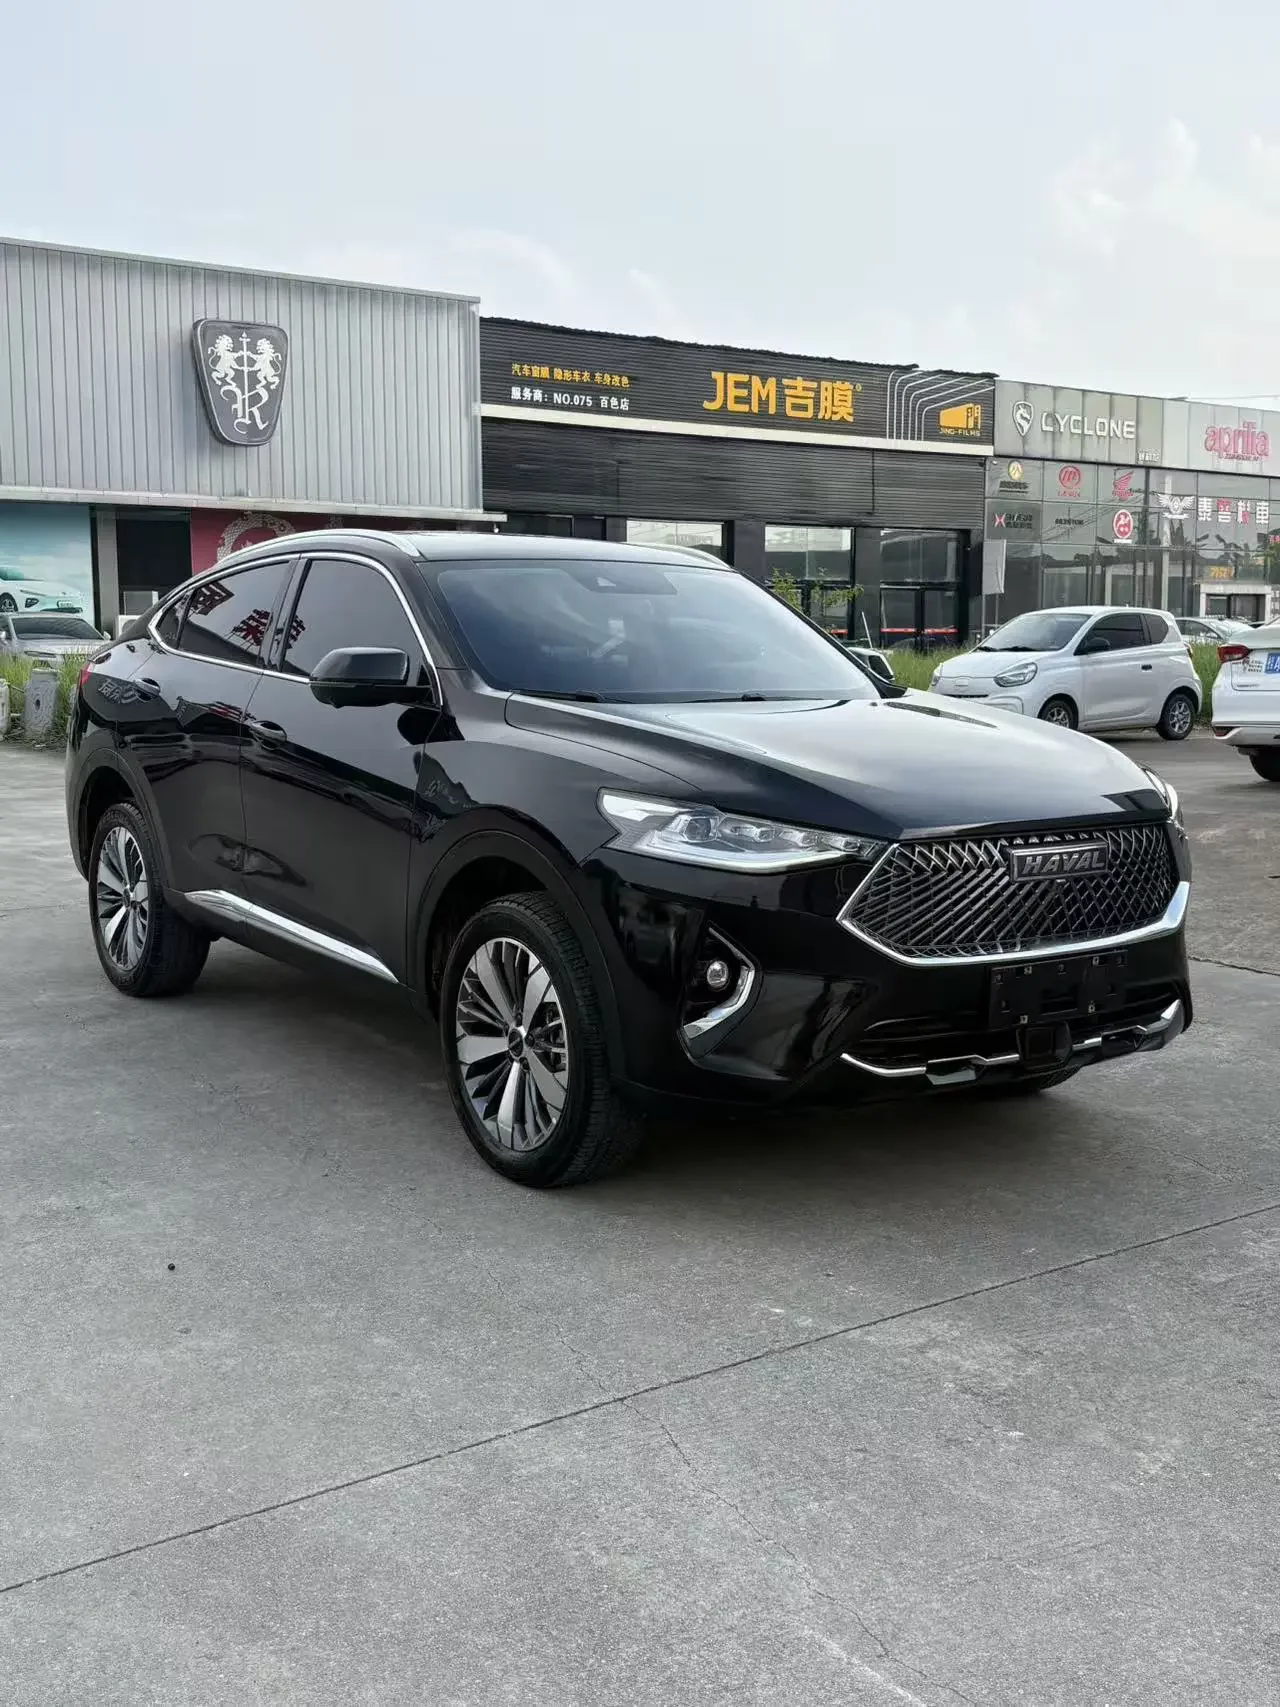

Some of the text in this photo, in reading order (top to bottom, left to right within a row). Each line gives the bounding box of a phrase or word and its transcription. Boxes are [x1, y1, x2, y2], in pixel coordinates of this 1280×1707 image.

[594, 372, 630, 387] 车身改色
[553, 393, 593, 407] NO.075
[599, 396, 630, 411] 百色店
[703, 371, 777, 414] JEM
[1204, 420, 1270, 459] aprilia
[1022, 851, 1104, 874] HAVAL
